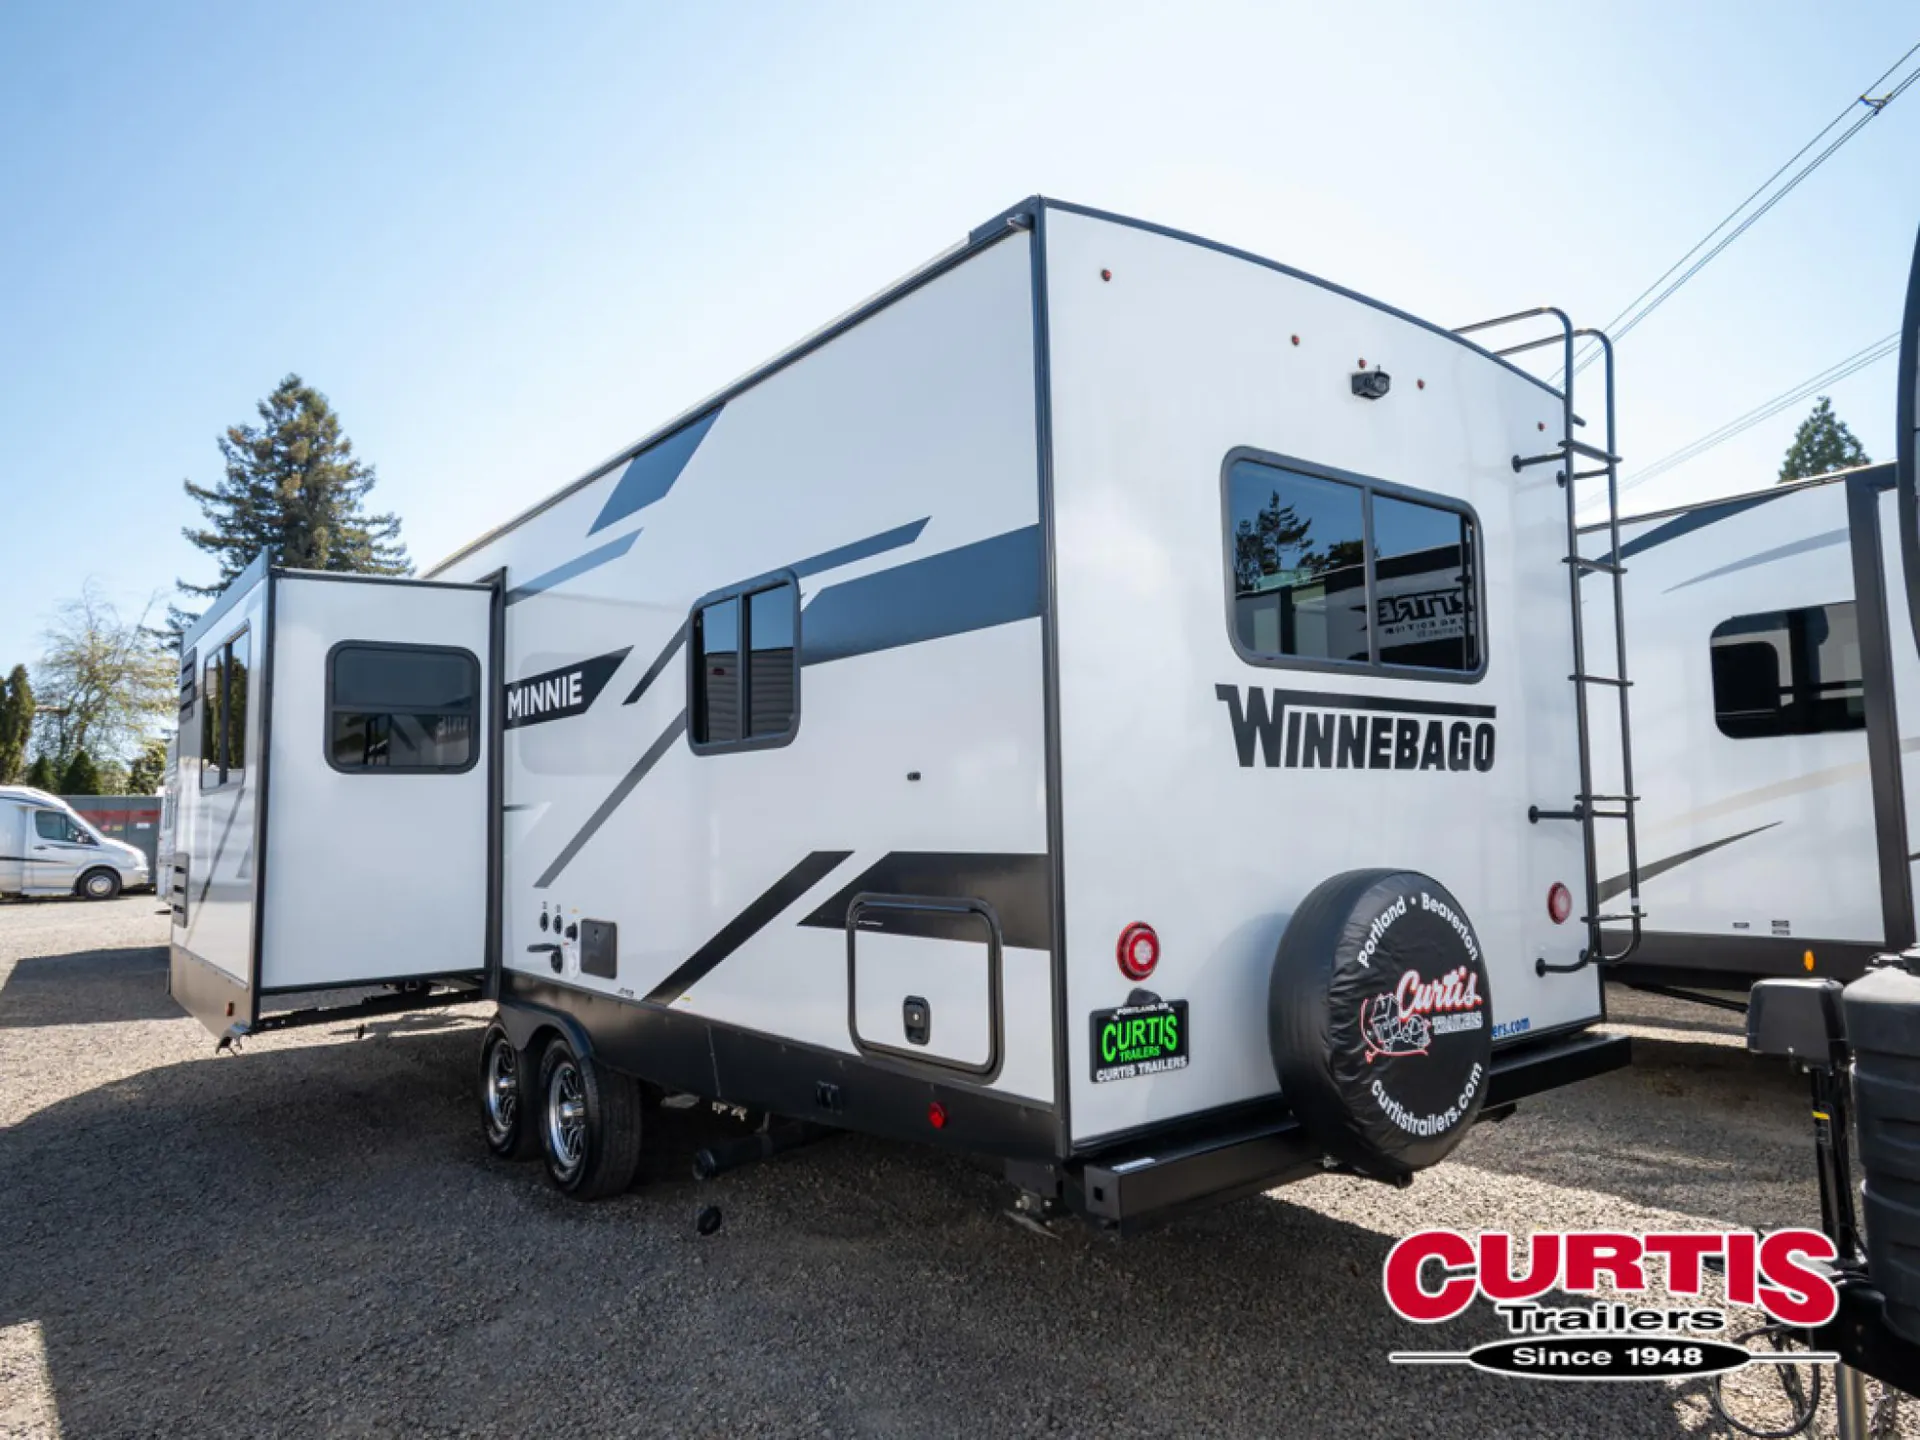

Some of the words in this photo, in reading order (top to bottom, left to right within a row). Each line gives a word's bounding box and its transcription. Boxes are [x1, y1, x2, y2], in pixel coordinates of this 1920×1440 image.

[507, 671, 582, 719] MINNIE
[1215, 684, 1496, 772] WINNEBAGO
[1357, 895, 1407, 968] Portland
[1421, 892, 1478, 961] Beaverton
[1397, 966, 1482, 1022] Curtis
[1102, 1014, 1178, 1062] CURTIS
[1120, 1045, 1161, 1062] TRAILERS
[1096, 1064, 1136, 1081] CURTIS
[1138, 1056, 1187, 1075] TRAILERS
[1371, 1062, 1483, 1136] curtistrailers.com
